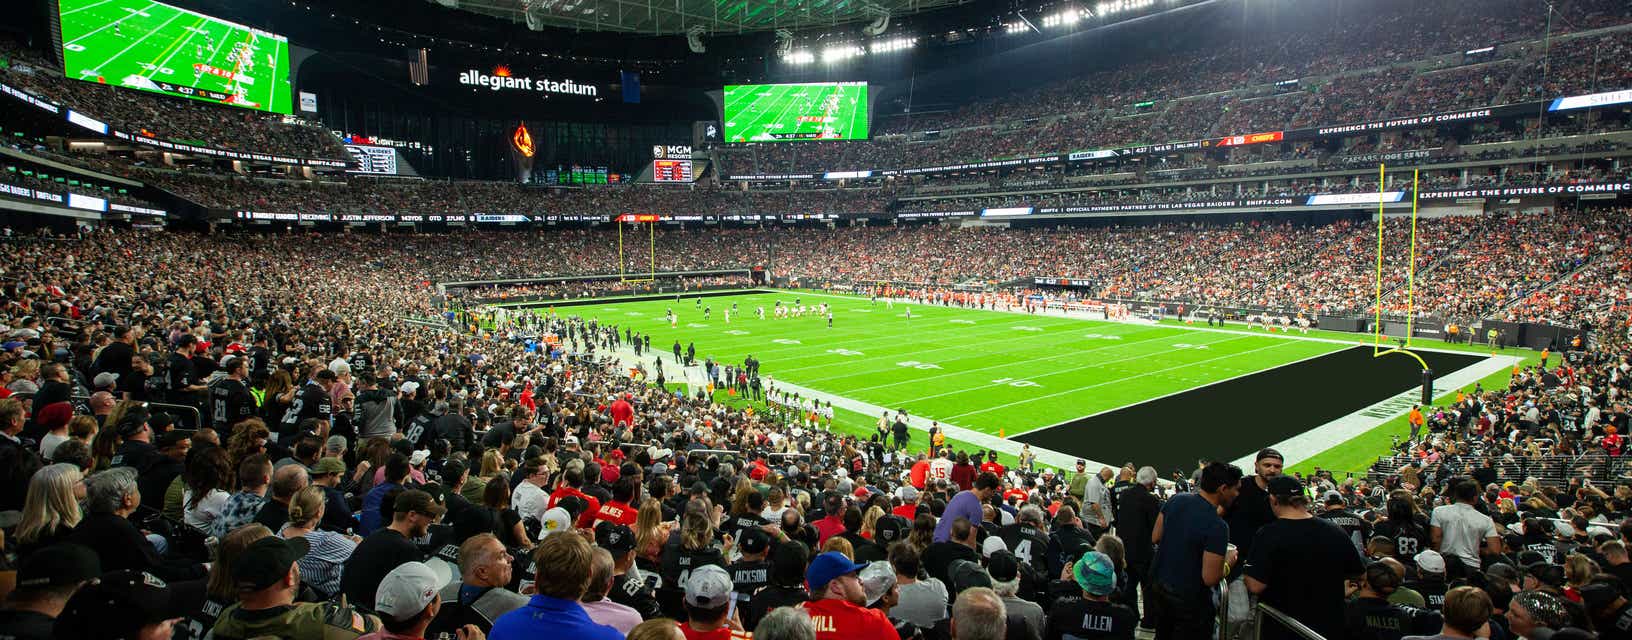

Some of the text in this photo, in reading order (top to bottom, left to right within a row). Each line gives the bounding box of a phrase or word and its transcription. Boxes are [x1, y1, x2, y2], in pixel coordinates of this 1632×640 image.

[460, 69, 598, 97] allegiant stadium
[1319, 109, 1491, 135] EXPERIENCE THE FUTURE OF COMMERCE
[191, 146, 217, 155] PARTNER
[273, 156, 298, 164] RAIDERS
[668, 146, 692, 154] MGM
[1419, 183, 1632, 199] EXPERIENCE THE FUTURE OF COMMERC
[1246, 198, 1292, 206] SHIFT4.COM
[935, 467, 945, 479] 15
[1014, 539, 1032, 567] 4
[1398, 536, 1418, 555] 83
[733, 569, 767, 584] JACKSON
[1082, 613, 1113, 633] ALLEN
